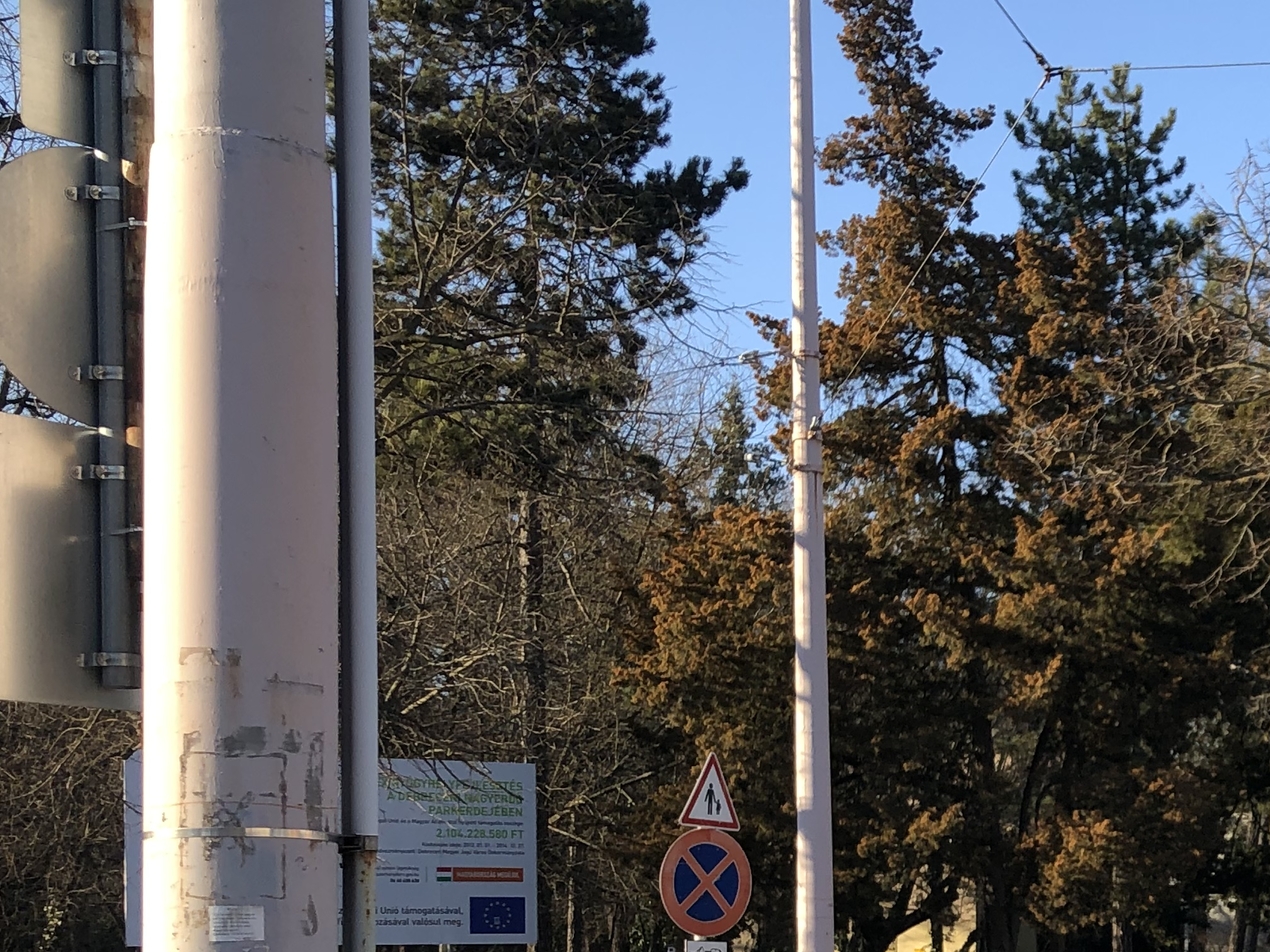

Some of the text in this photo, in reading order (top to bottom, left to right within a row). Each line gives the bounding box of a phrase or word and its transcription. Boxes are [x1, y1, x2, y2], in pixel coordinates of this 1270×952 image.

[429, 805, 523, 816] PARKERDEJÉBEN
[436, 828, 524, 839] 2.104.228.580 FT
[380, 906, 399, 914] Unió
[401, 906, 464, 916] támogatásával,
[412, 917, 441, 926] valósul
[443, 919, 464, 927] meg.
